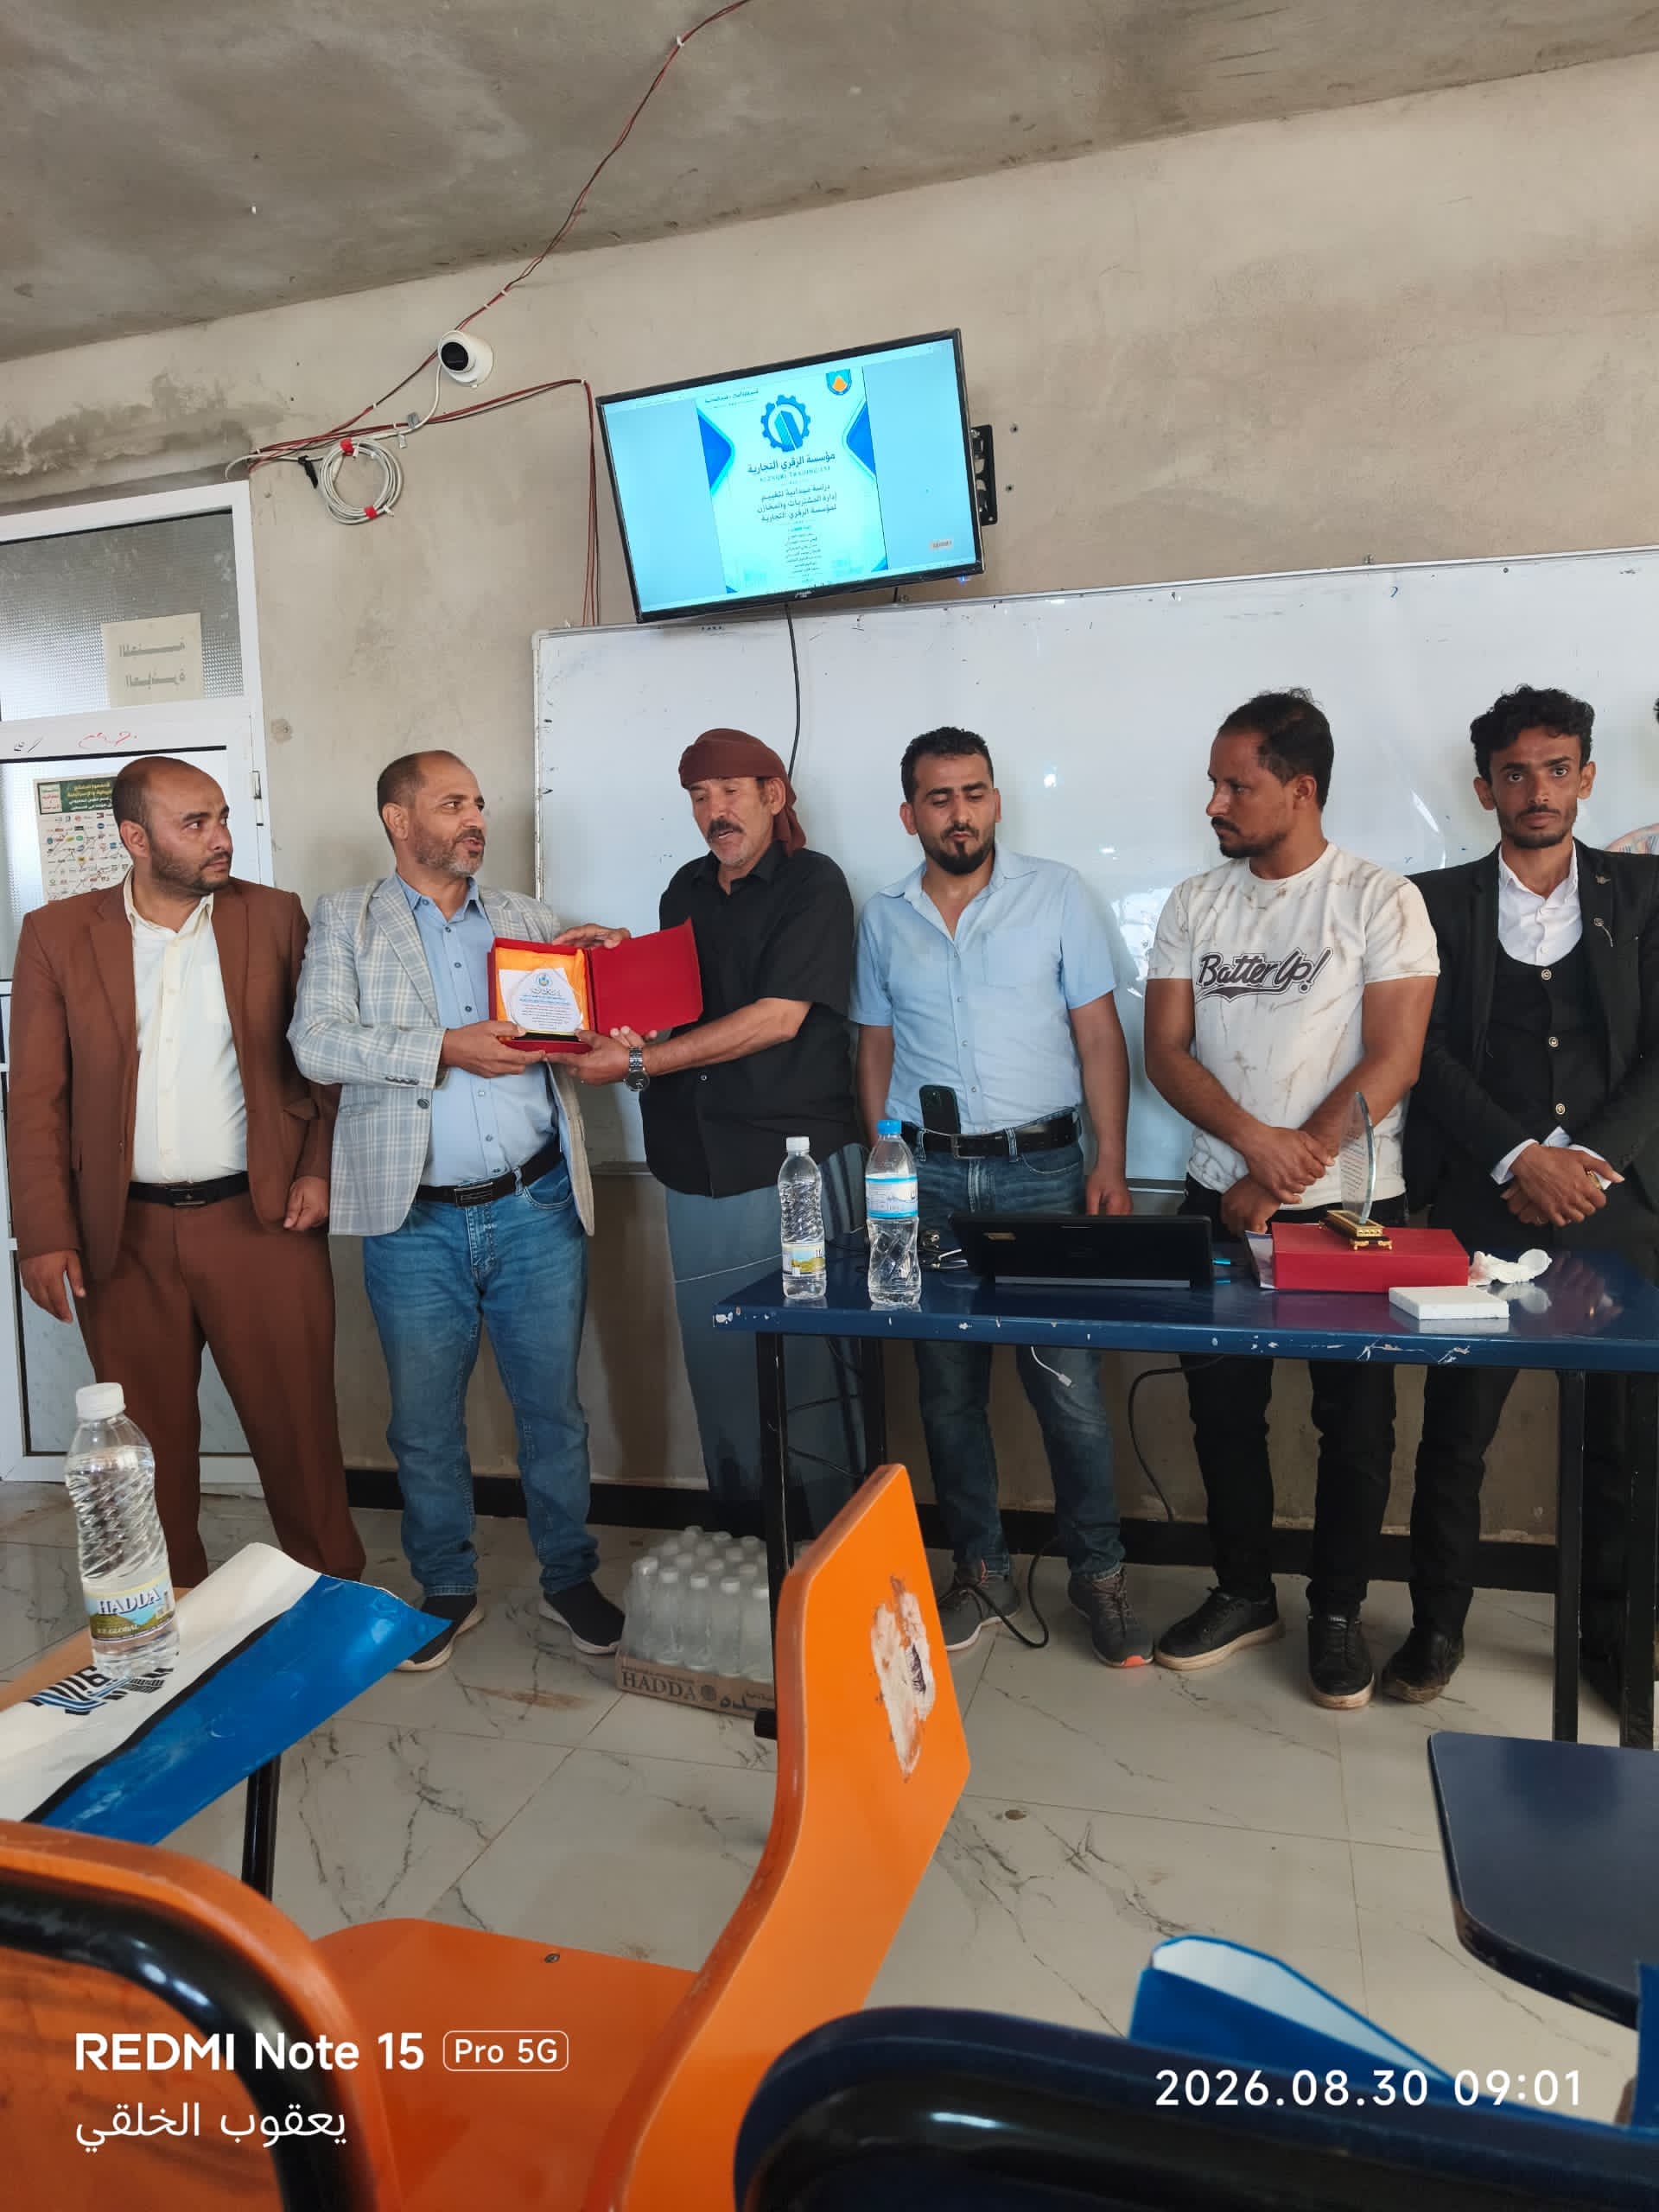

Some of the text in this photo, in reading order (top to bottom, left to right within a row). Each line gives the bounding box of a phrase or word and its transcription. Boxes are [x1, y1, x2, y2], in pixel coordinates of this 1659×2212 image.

[806, 451, 836, 464] مؤسسة
[1197, 948, 1333, 994] Batter Up!
[99, 1587, 162, 1615] HADDA
[621, 1671, 696, 1701] HADDA
